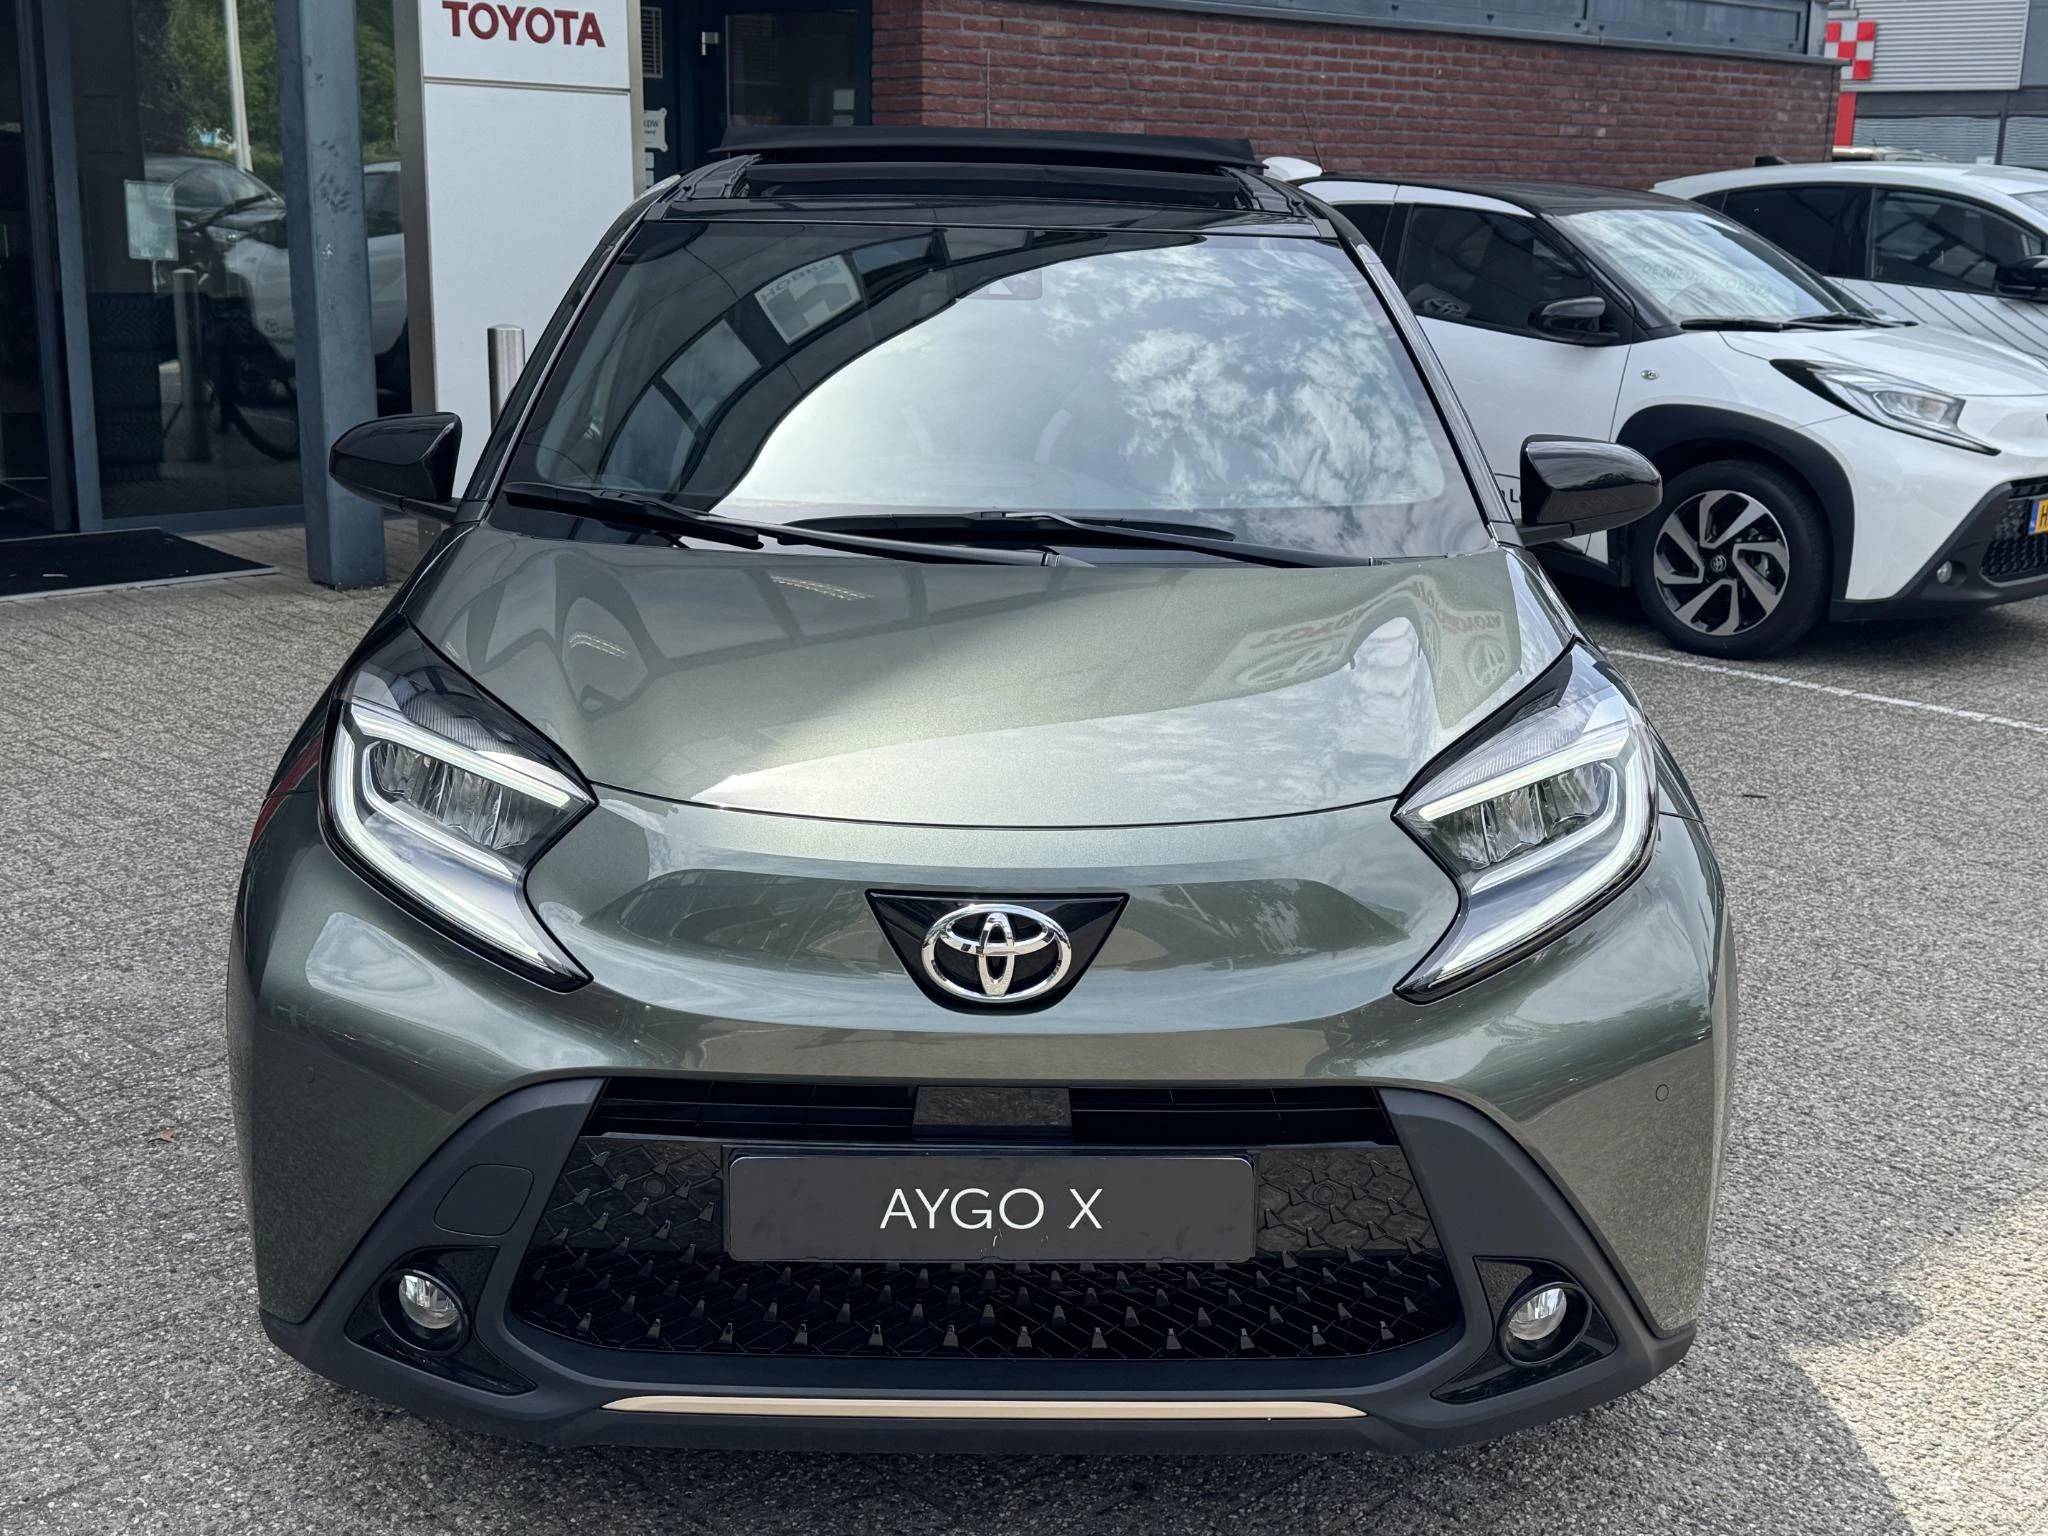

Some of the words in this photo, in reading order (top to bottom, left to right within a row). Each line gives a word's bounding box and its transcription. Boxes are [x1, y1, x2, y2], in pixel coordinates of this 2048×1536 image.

[442, 0, 606, 48] TOYOTA
[879, 1188, 1044, 1230] AYGO
[1068, 1188, 1103, 1230] X
